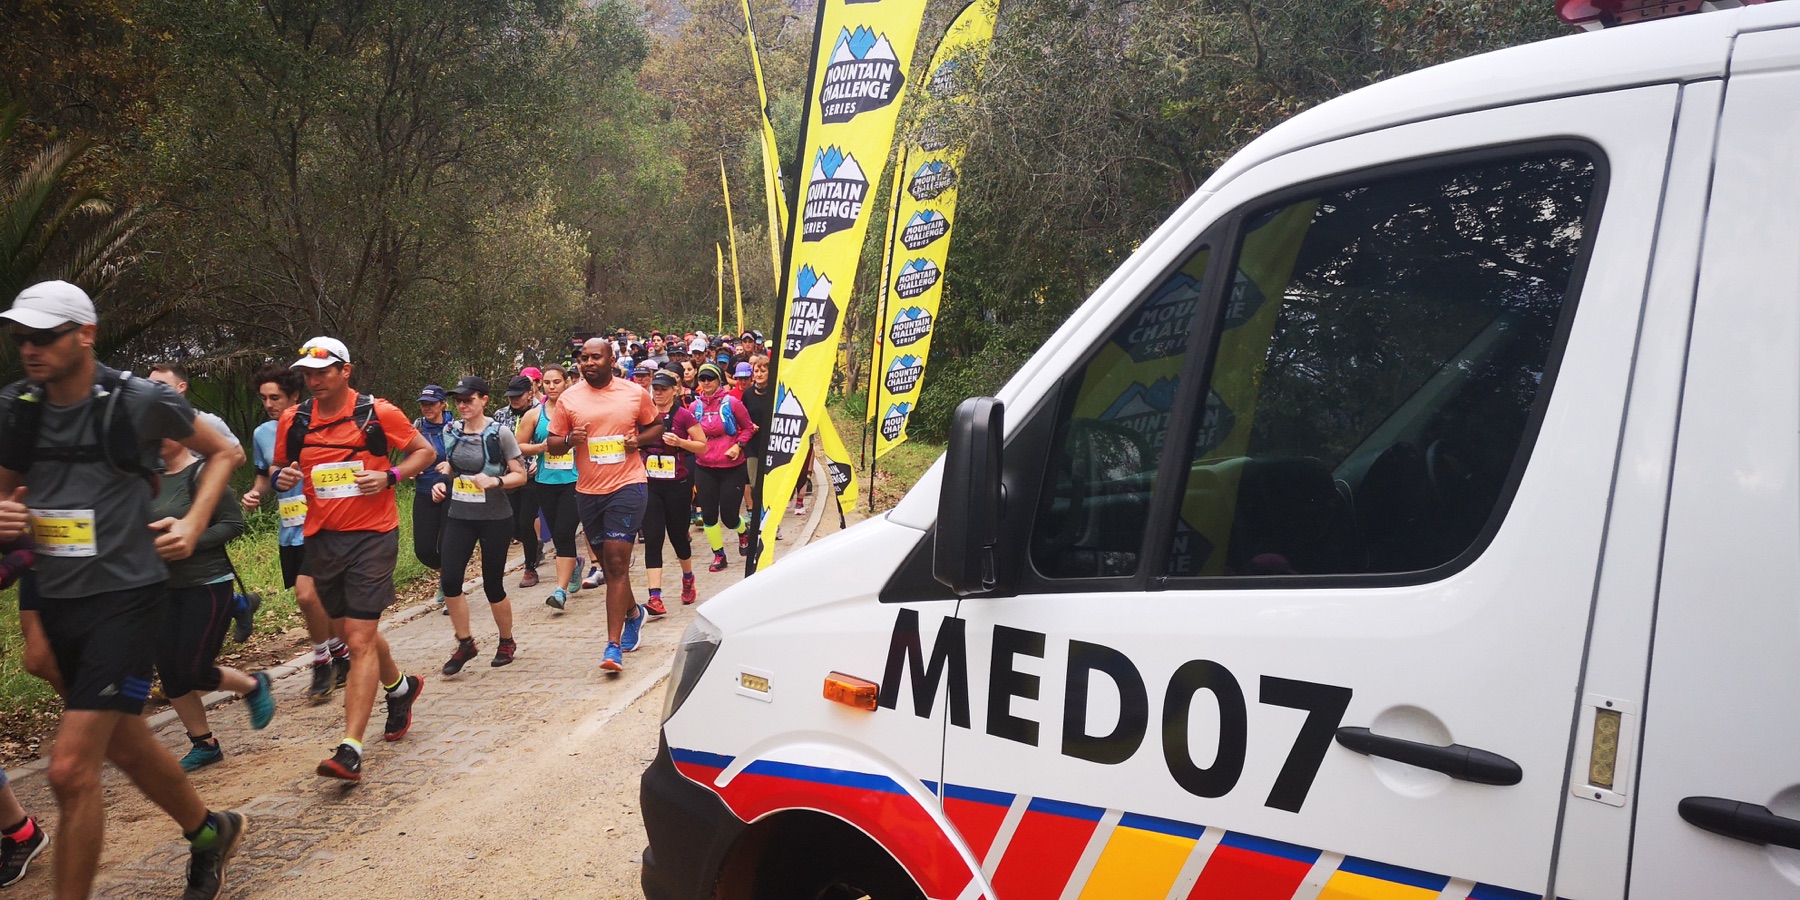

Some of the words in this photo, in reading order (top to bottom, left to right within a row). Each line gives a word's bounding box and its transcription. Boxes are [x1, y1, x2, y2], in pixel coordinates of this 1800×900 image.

[826, 62, 894, 86] MOUNTAIN
[822, 81, 892, 104] CHALLENGE
[824, 102, 857, 117] SERIES
[807, 182, 863, 204] OUNTAIN
[904, 228, 945, 243] CHALLENGE
[906, 220, 944, 236] MOUNTAIN
[909, 239, 930, 249] SERIES
[897, 276, 936, 292] CHALLENGE
[899, 269, 937, 284] MOUNTAIN
[902, 288, 923, 297] SERIES
[893, 317, 931, 332] MOUNTAIN
[891, 325, 931, 340] CHALLENGE
[896, 335, 917, 345] SERIES
[888, 366, 921, 380] MOUNTAI
[887, 374, 918, 388] CHALLEN
[892, 383, 913, 393] SERIES
[594, 444, 614, 453] 2211
[321, 472, 347, 483] 2334
[878, 607, 1353, 814] MED07
